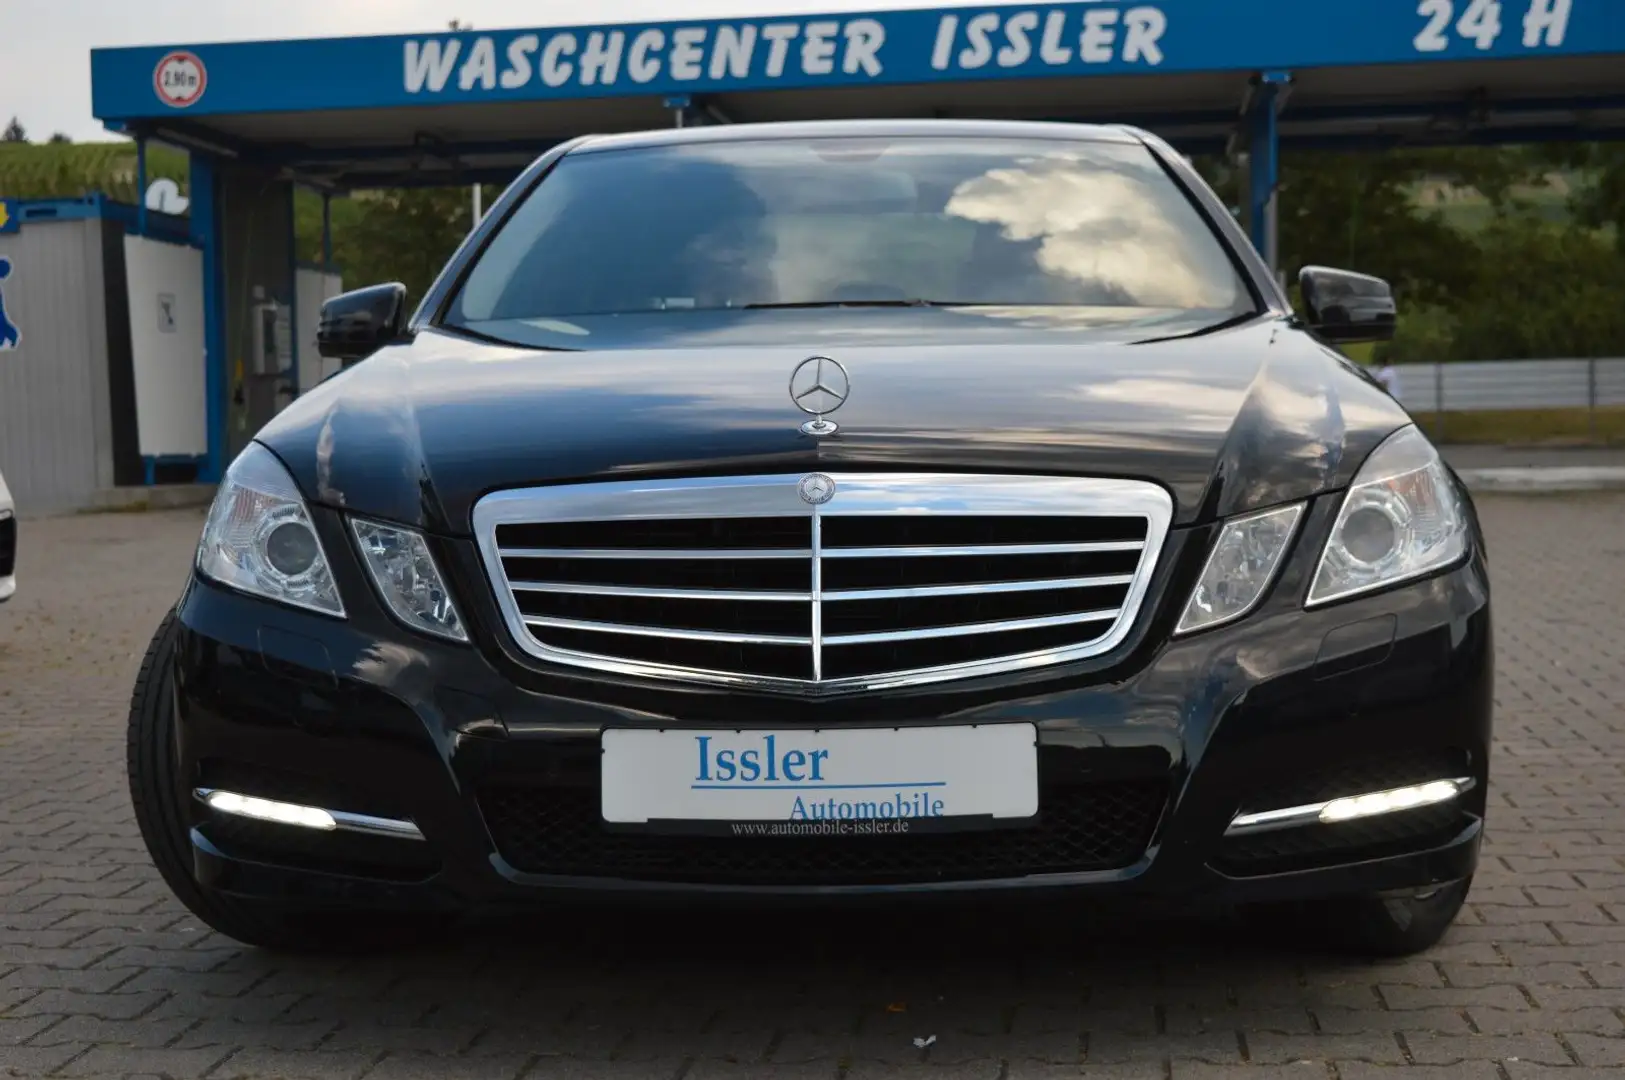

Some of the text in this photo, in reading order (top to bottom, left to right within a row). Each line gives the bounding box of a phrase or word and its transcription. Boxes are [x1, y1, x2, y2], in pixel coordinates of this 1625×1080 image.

[1413, 0, 1573, 51] 24 H
[403, 6, 1167, 94] WASCHCENTER ISSLER
[694, 734, 829, 782] Issler
[731, 819, 909, 836] www.automobile-issler.de
[789, 792, 945, 820] Automobile
